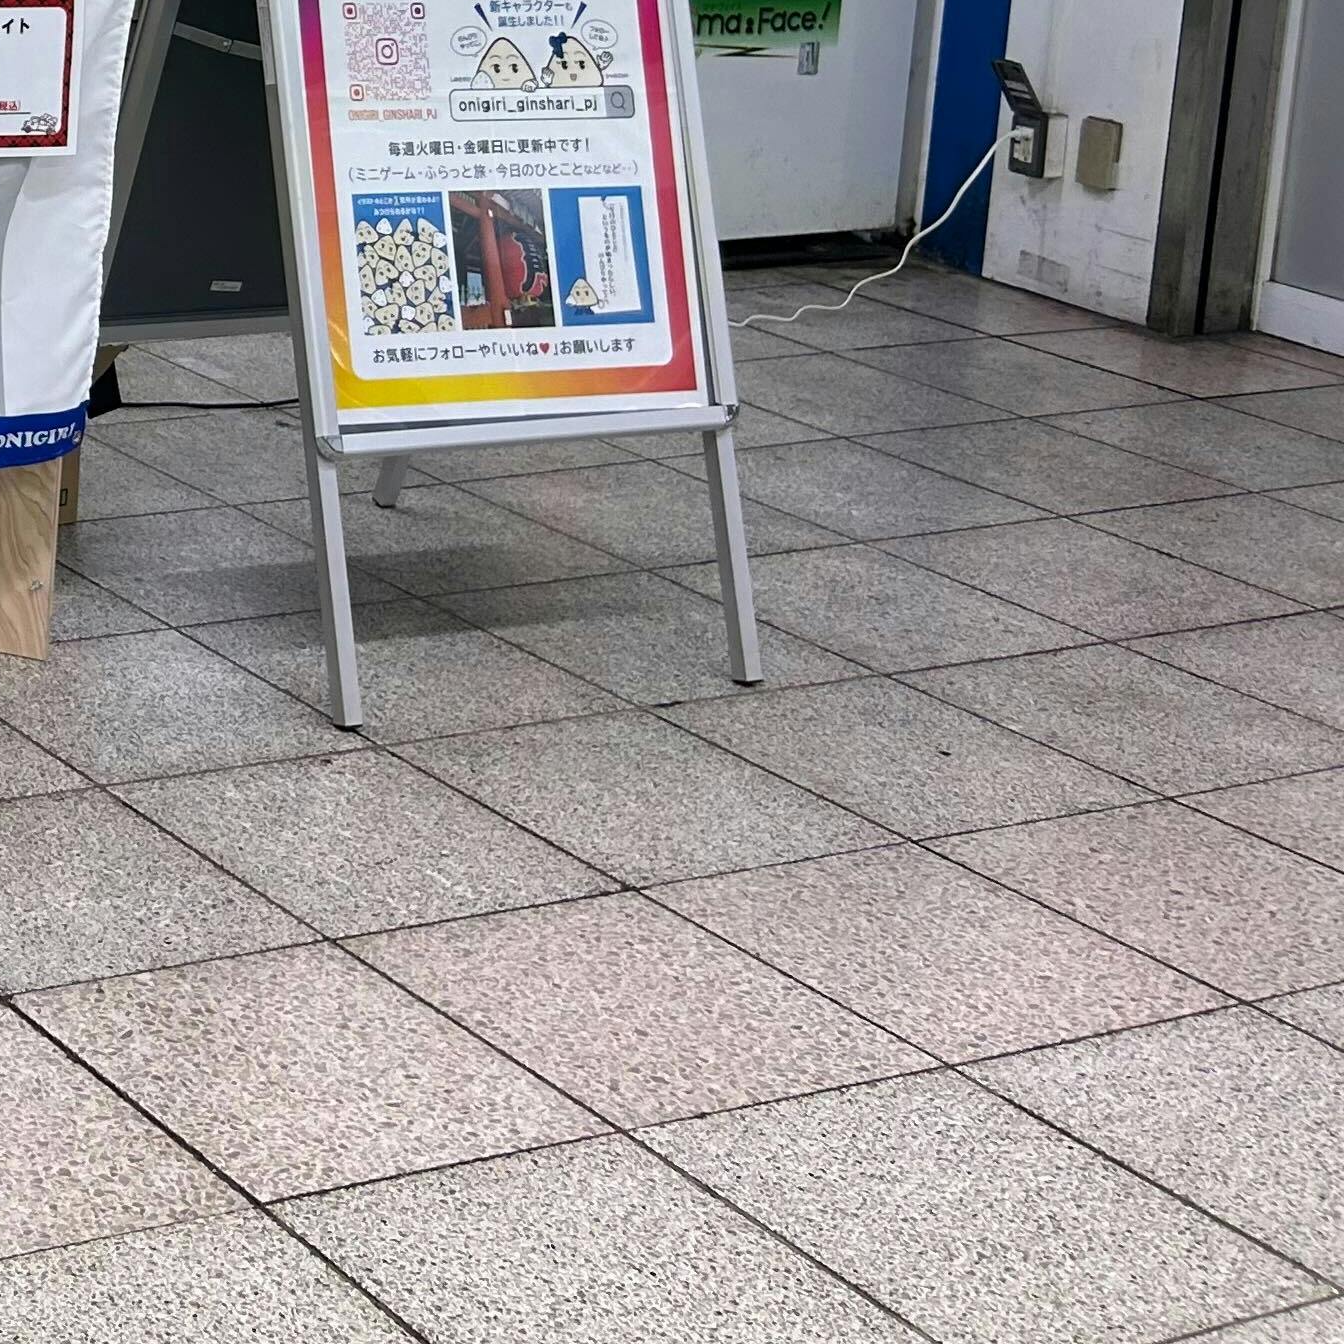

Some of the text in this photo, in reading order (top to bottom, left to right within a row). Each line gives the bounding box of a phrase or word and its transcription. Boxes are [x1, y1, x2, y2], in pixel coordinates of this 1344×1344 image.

[489, 0, 573, 13] 新キャラクターも
[497, 14, 564, 28] 誕生しました!!
[458, 96, 598, 115] onigiri_ginshari_pj
[388, 139, 591, 157] 毎週火曜日・金曜日に更新中です!
